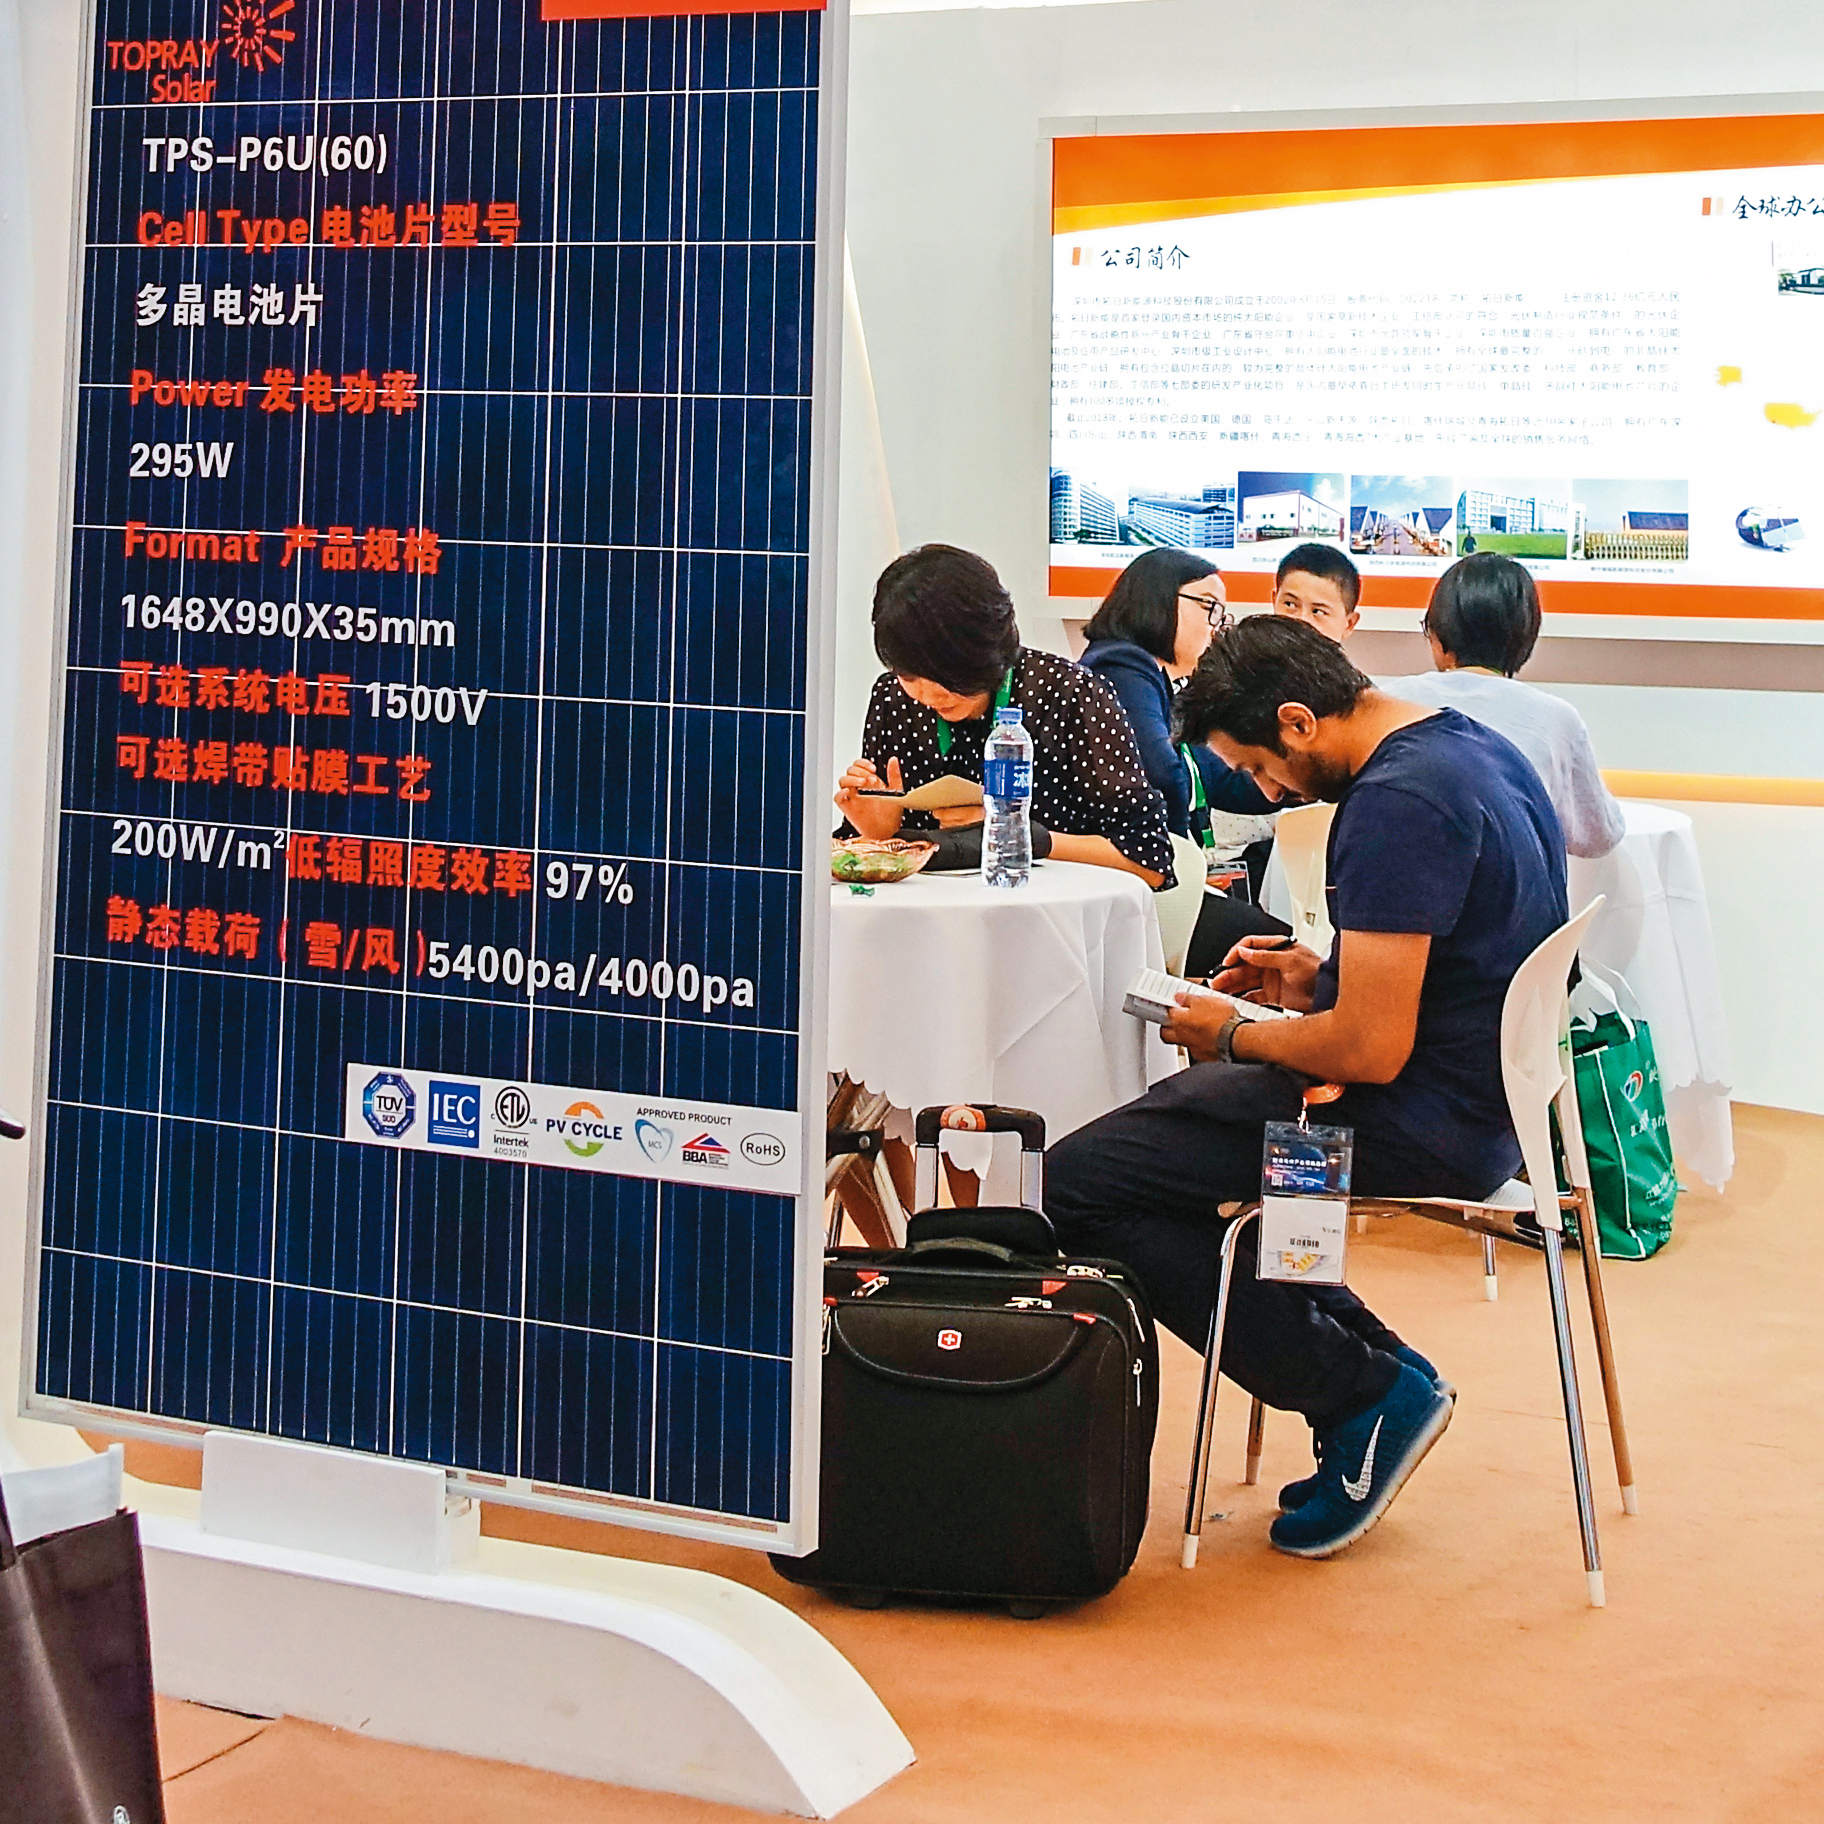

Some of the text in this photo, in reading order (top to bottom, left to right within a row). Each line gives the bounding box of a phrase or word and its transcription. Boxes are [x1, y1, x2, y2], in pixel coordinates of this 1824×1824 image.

[108, 39, 219, 72] TOPRAY
[152, 72, 217, 103] Solar
[144, 132, 387, 176] TPS-P6U(60)
[137, 202, 520, 256] Cell Type 电池片型号
[1101, 245, 1190, 270] 公司简介
[135, 281, 323, 328] 多晶电池片
[130, 368, 418, 415] Power 发电功率
[129, 441, 233, 480] 295W
[124, 521, 442, 575] Format 产品规格
[120, 593, 456, 648] 1648X990X35mm
[119, 661, 488, 726] 可选系统电压 1500V
[116, 734, 432, 802] 可选焊带贴膜工艺
[545, 862, 635, 906] 97%
[427, 941, 755, 1013] 5400pa/4000pa
[433, 1093, 476, 1125] IEC
[636, 1107, 733, 1126] APPROVED PRODUCT
[493, 1134, 529, 1148] Intertek
[546, 1119, 623, 1141] PV CYCLE
[746, 1142, 780, 1157] RoHS
[682, 1151, 707, 1164] BBA
